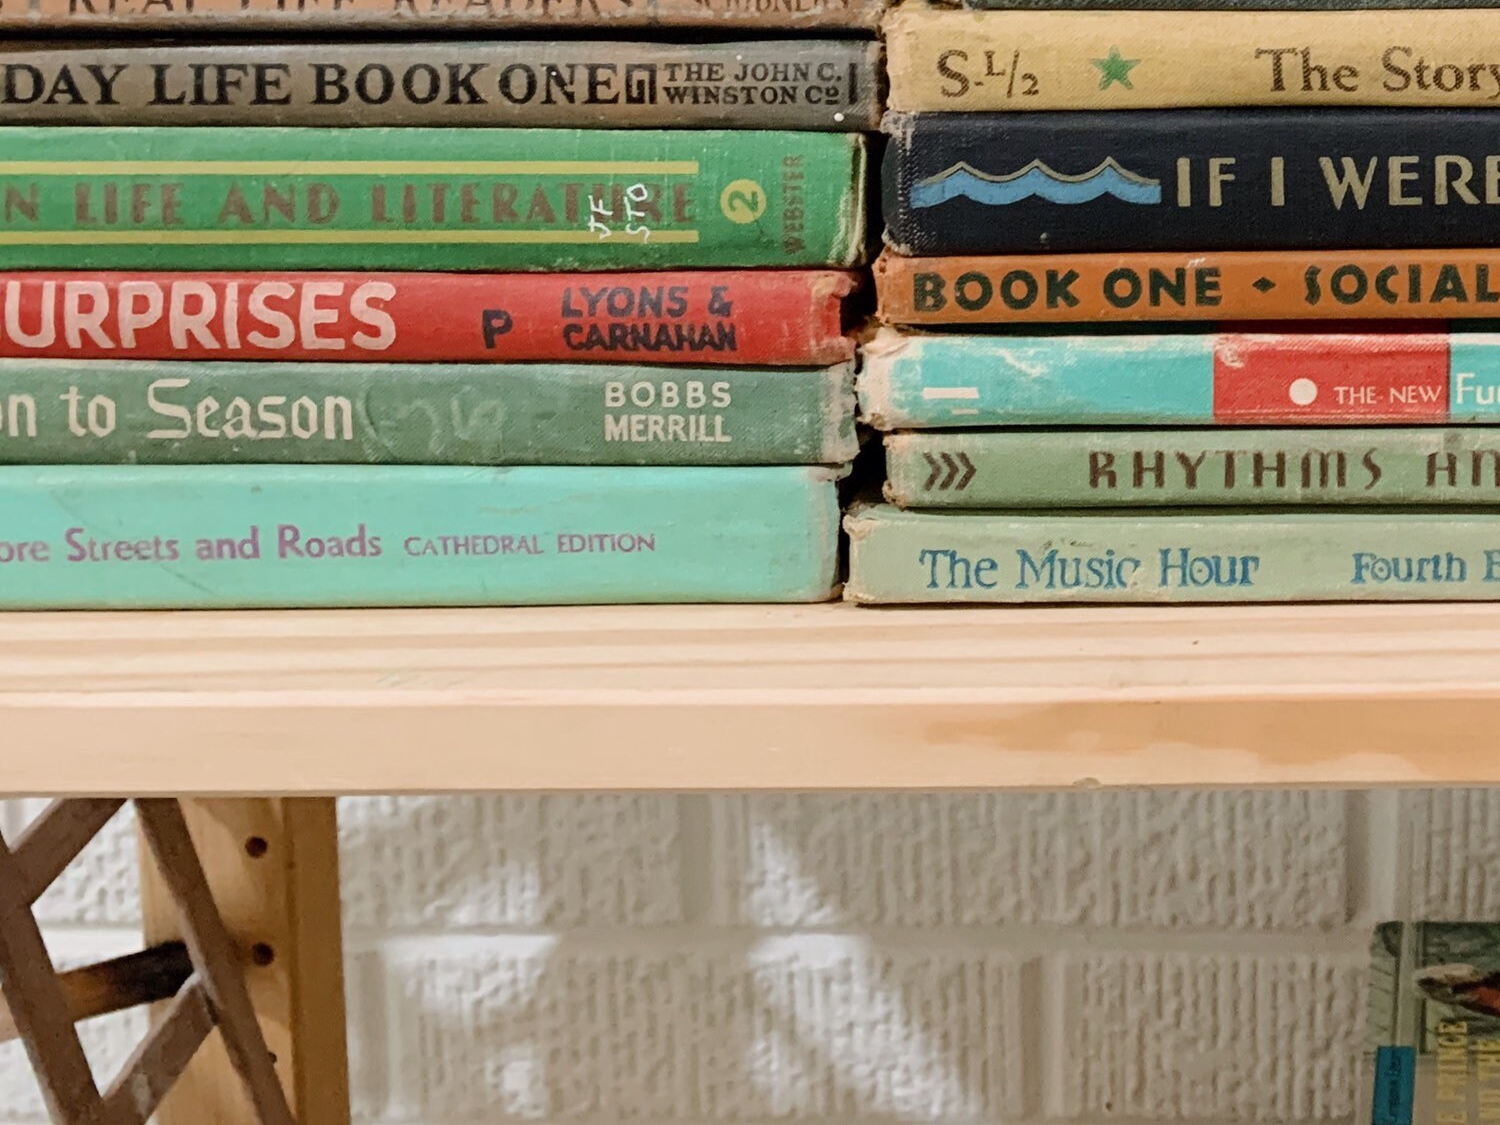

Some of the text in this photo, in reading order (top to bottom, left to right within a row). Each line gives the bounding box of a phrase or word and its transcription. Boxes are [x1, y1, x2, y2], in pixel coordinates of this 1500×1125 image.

[0, 62, 622, 106] DAY LIFE BOOK ONE
[663, 62, 843, 83] THE JOHN C.
[1254, 46, 1360, 93] The
[662, 85, 801, 106] WINSTON
[726, 189, 759, 213] 2
[1175, 156, 1238, 208] IF
[1270, 156, 1285, 207] I
[73, 182, 186, 226] LIFE
[217, 182, 342, 225] AND
[369, 182, 696, 225] LITERATURE
[782, 154, 806, 255] WEBSTER
[560, 285, 734, 319] LYONS &
[912, 267, 1081, 313] BOOK
[1102, 267, 1224, 309] ONE
[1303, 263, 1500, 307] SOCIAL
[4, 279, 398, 351] URPRISES
[481, 308, 514, 350] P
[562, 322, 738, 352] CARNAHAN
[60, 385, 118, 439] to
[145, 378, 355, 441] Season
[604, 381, 733, 408] BOBBS
[1333, 385, 1442, 405] THE NEW
[604, 414, 733, 444] MERRILL
[1088, 447, 1384, 491] RHYTHMS
[64, 527, 181, 563] Streets
[193, 525, 261, 561] and
[276, 523, 383, 559] Roads
[402, 531, 656, 558] CATHEDRAL EDITION
[918, 546, 1261, 591] The Music Hour
[1350, 549, 1468, 586] Fourth
